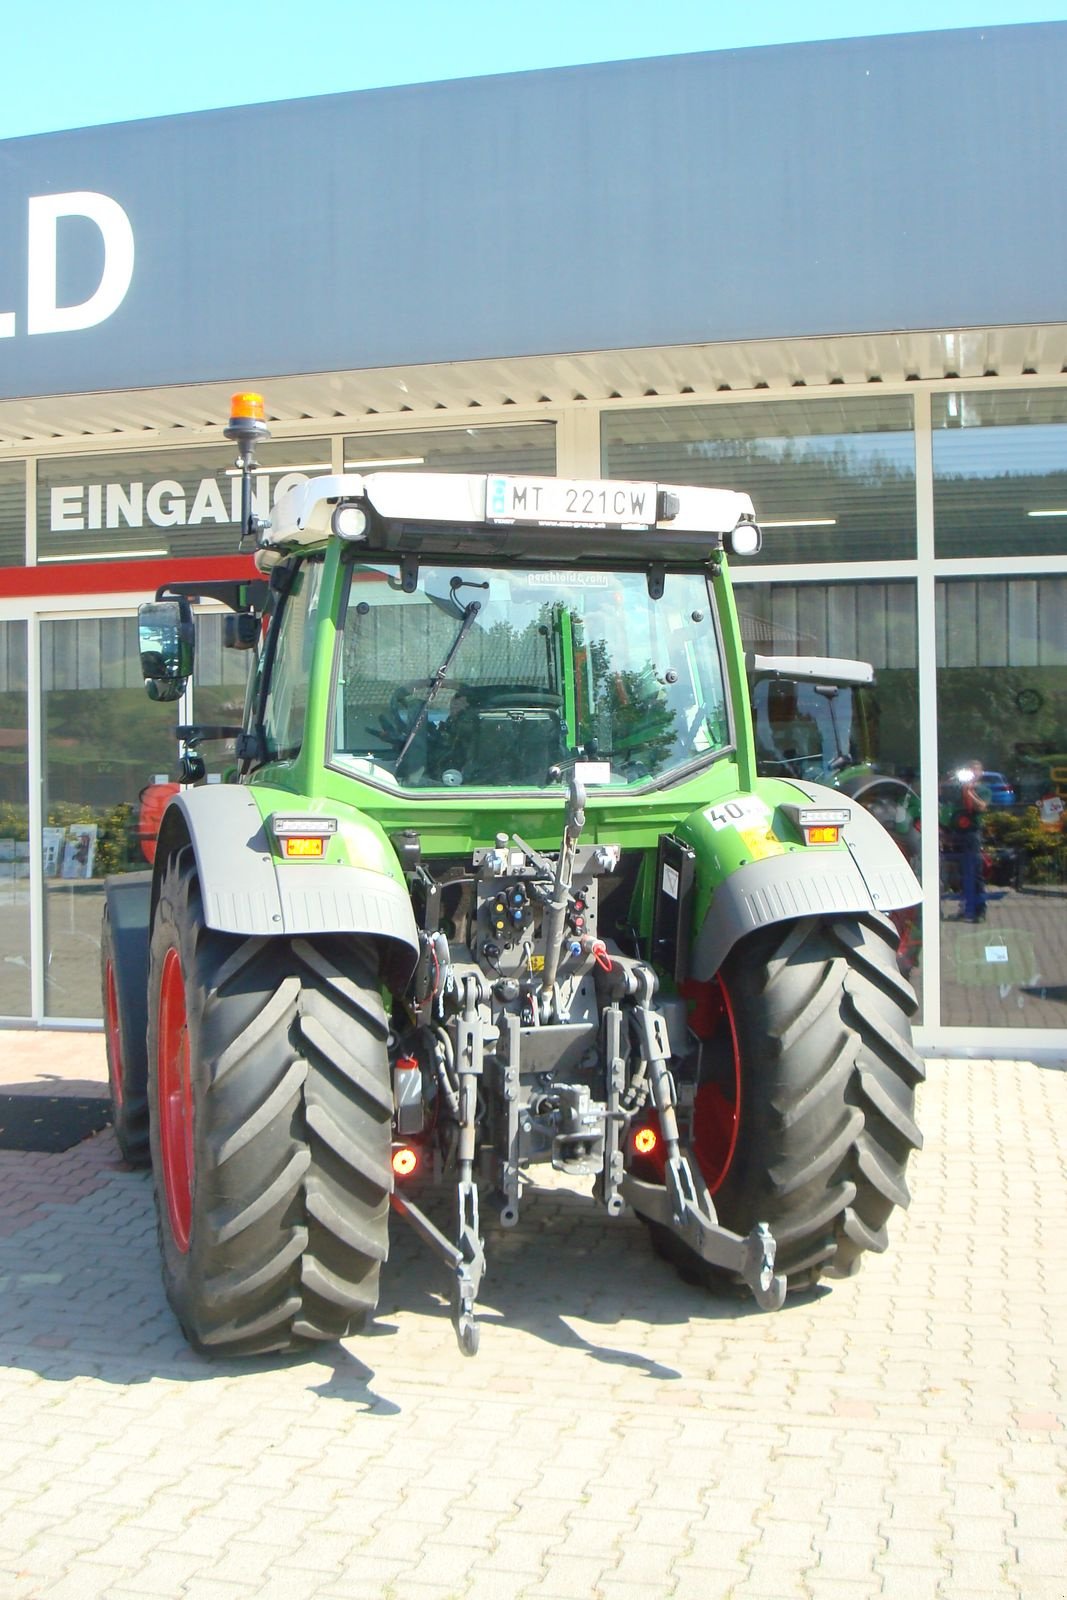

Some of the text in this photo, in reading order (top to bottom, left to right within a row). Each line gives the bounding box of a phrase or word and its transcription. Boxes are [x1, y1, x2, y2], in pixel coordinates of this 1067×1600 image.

[512, 486, 646, 515] MT 221CW
[710, 803, 745, 824] 40
